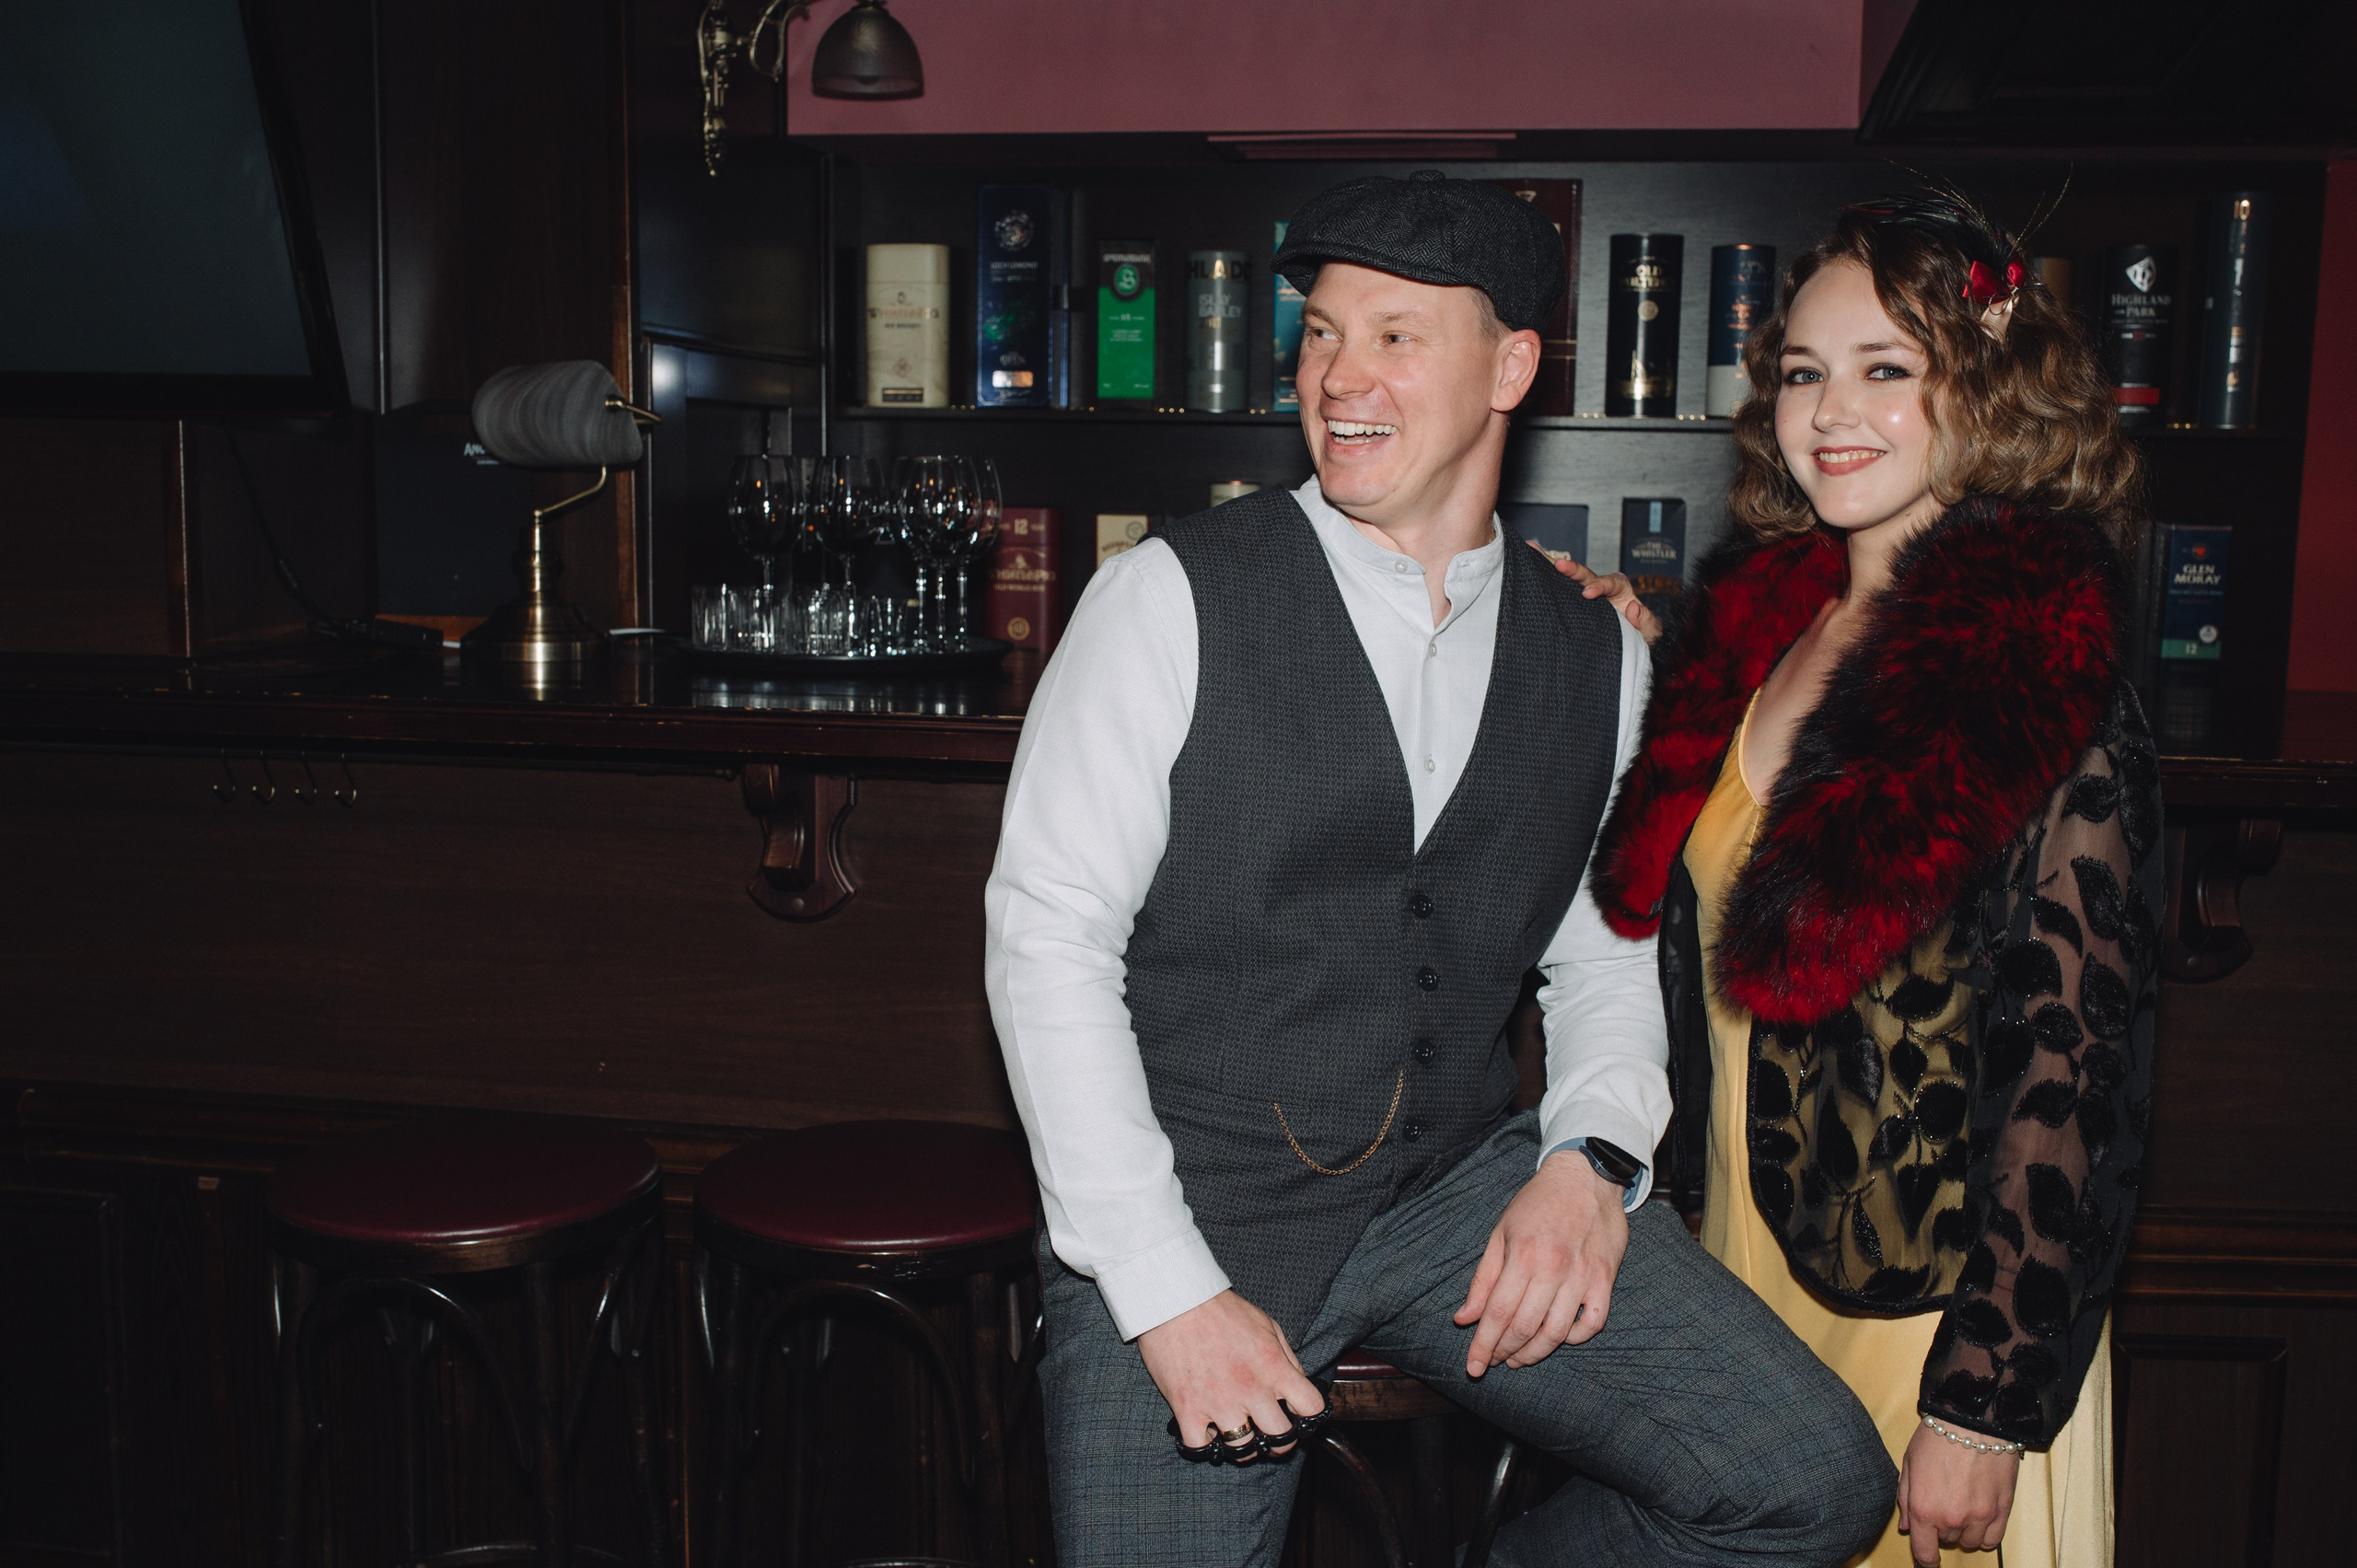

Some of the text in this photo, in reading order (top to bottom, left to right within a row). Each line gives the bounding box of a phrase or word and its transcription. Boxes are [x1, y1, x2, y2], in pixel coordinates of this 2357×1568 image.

[1014, 518, 1028, 535] 12
[2182, 563, 2215, 575] GLEN
[2174, 573, 2222, 587] MORAY
